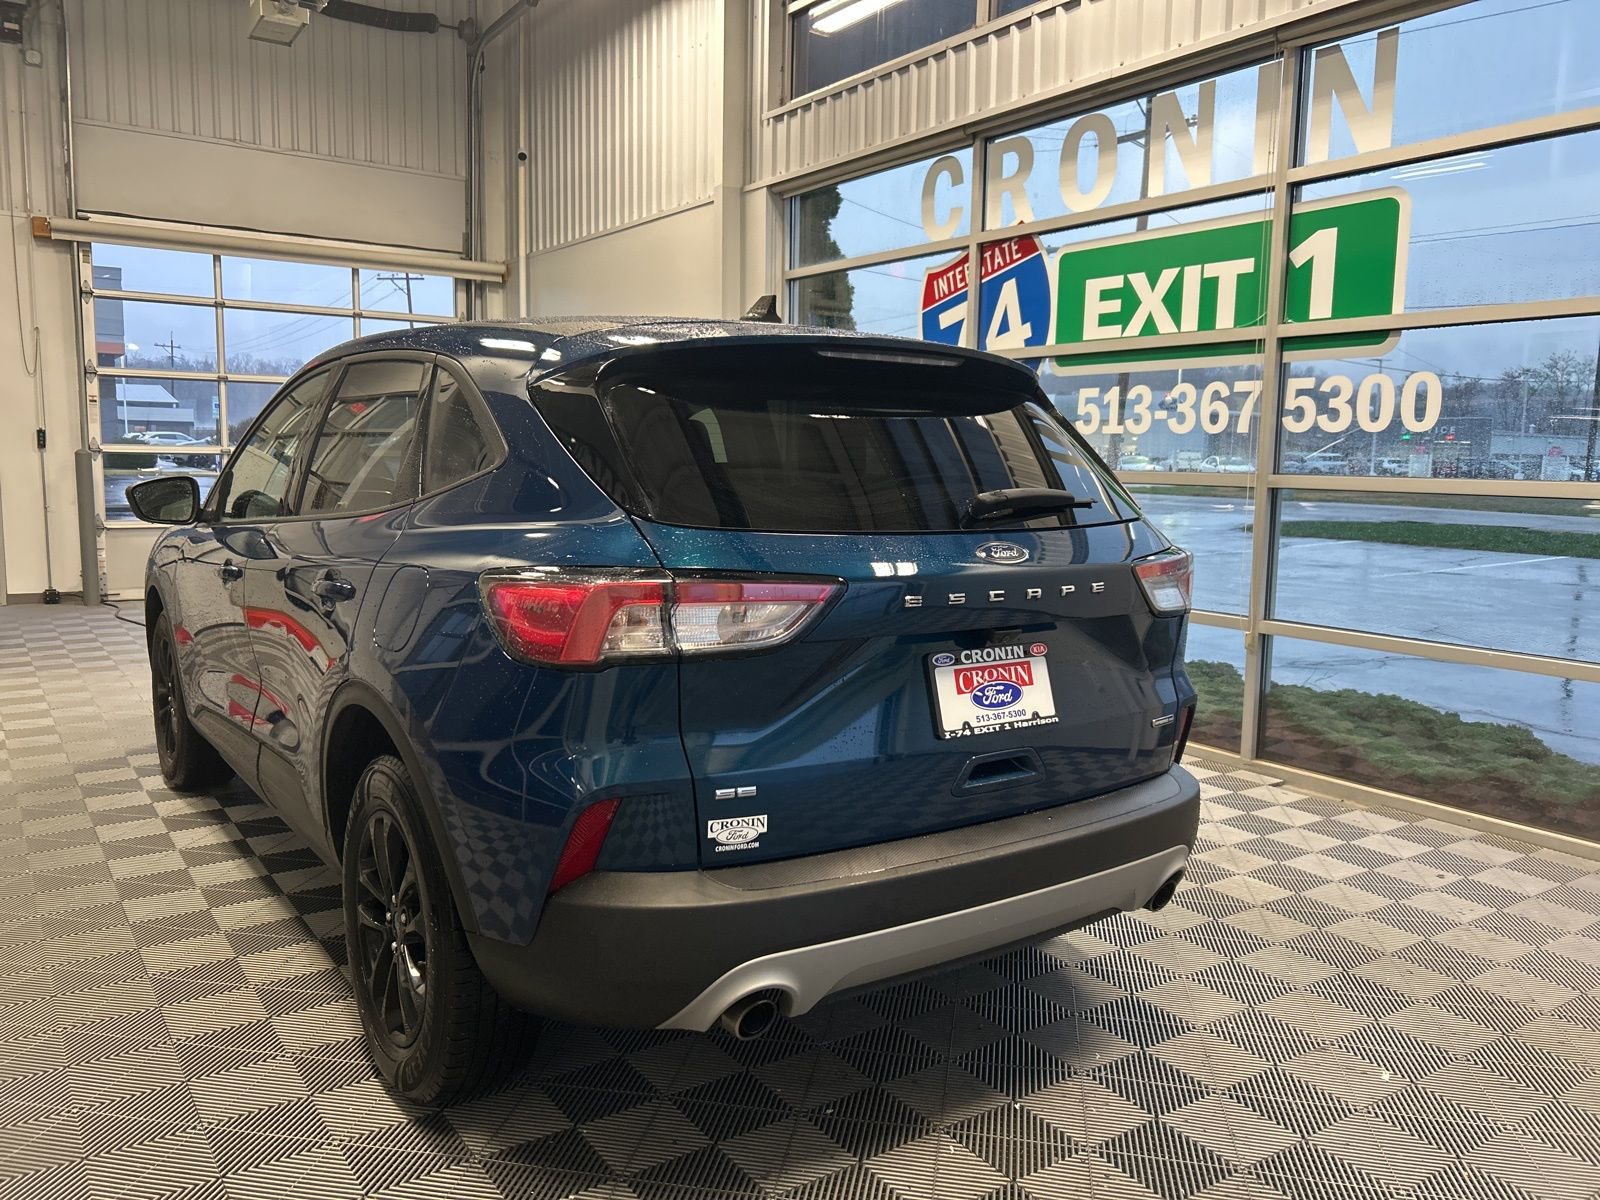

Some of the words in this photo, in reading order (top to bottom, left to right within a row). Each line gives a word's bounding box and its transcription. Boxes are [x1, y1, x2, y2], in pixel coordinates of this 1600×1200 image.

[921, 26, 1399, 241] CRONIN
[933, 237, 1022, 301] INTETATE
[1083, 257, 1255, 341] EXIT
[1289, 227, 1338, 320] 1
[1075, 371, 1443, 435] 513-3675300
[991, 544, 1019, 558] Ford
[904, 582, 1105, 608] ESCAPE
[960, 645, 1025, 664] CRONIN
[959, 664, 1031, 692] CRONIN
[982, 685, 1013, 705] Ford
[975, 709, 1027, 723] 513-367-5300
[944, 728, 971, 739] I-74
[973, 725, 1001, 735] EXIT
[1014, 716, 1059, 729] Harrison
[715, 785, 757, 800] SE
[709, 816, 766, 834] CRONIN
[725, 829, 749, 841] Ford
[715, 841, 760, 853] CRONINFORD.COM
